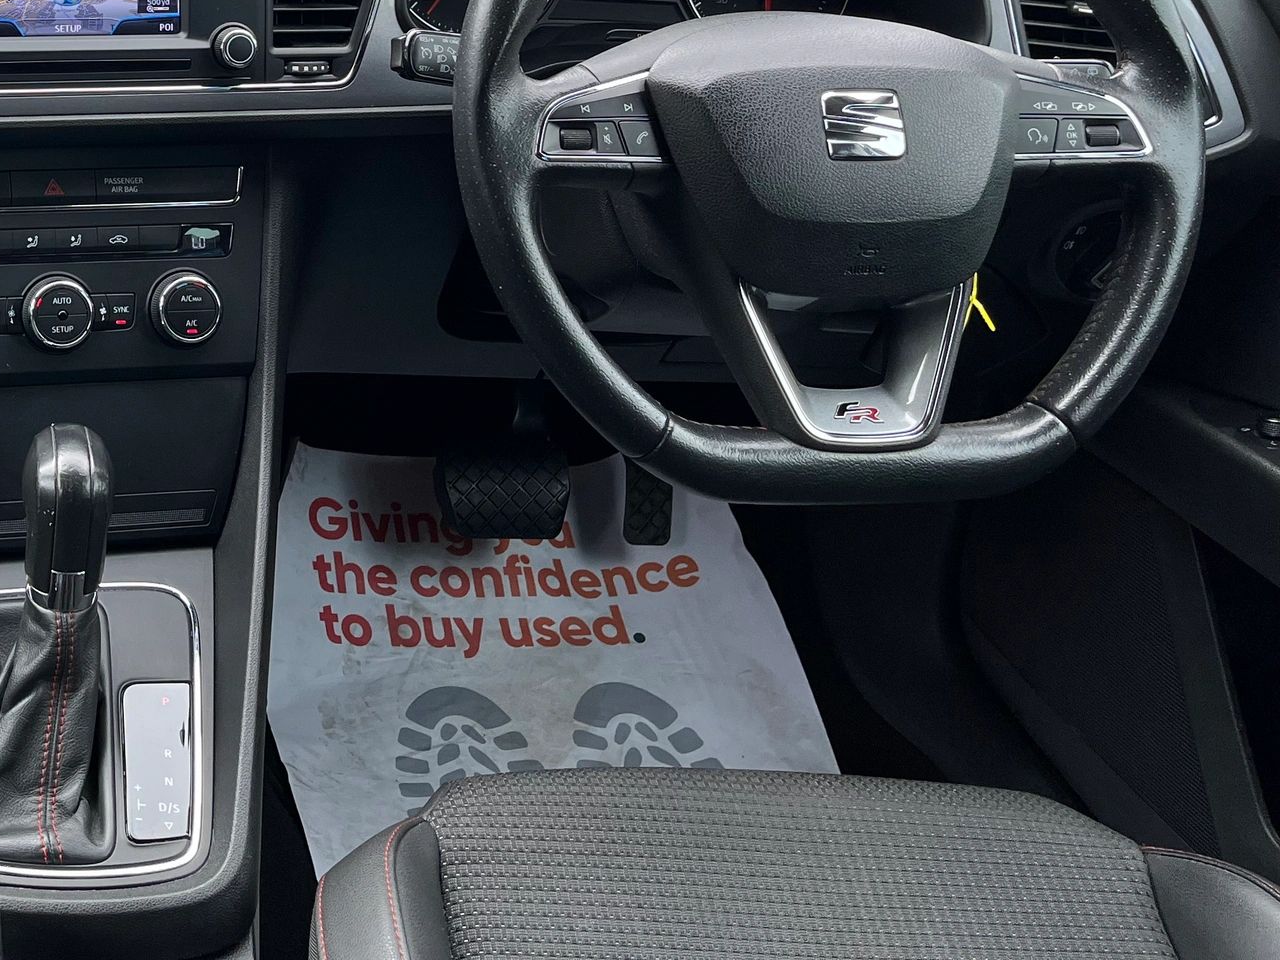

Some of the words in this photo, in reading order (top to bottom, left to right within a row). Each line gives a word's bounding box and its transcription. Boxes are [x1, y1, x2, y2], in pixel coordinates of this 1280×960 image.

[54, 24, 82, 32] SETUP
[159, 23, 174, 31] POI
[1066, 131, 1078, 140] OK
[104, 176, 144, 185] PASSENGER
[111, 185, 123, 194] AIR
[124, 185, 139, 193] BAG
[52, 297, 72, 305] AUTO
[113, 305, 130, 314] SYNC
[185, 319, 198, 327] A/C
[51, 326, 74, 334] SETUP
[834, 401, 884, 424] FR
[309, 497, 473, 556] Giving
[313, 551, 398, 597] the
[410, 554, 700, 600] confidence
[319, 604, 372, 646] to
[386, 603, 484, 659] buy
[499, 604, 647, 648] used.
[161, 696, 170, 706] P
[164, 749, 172, 758] R
[165, 777, 173, 787] N
[158, 802, 181, 814] D/S
